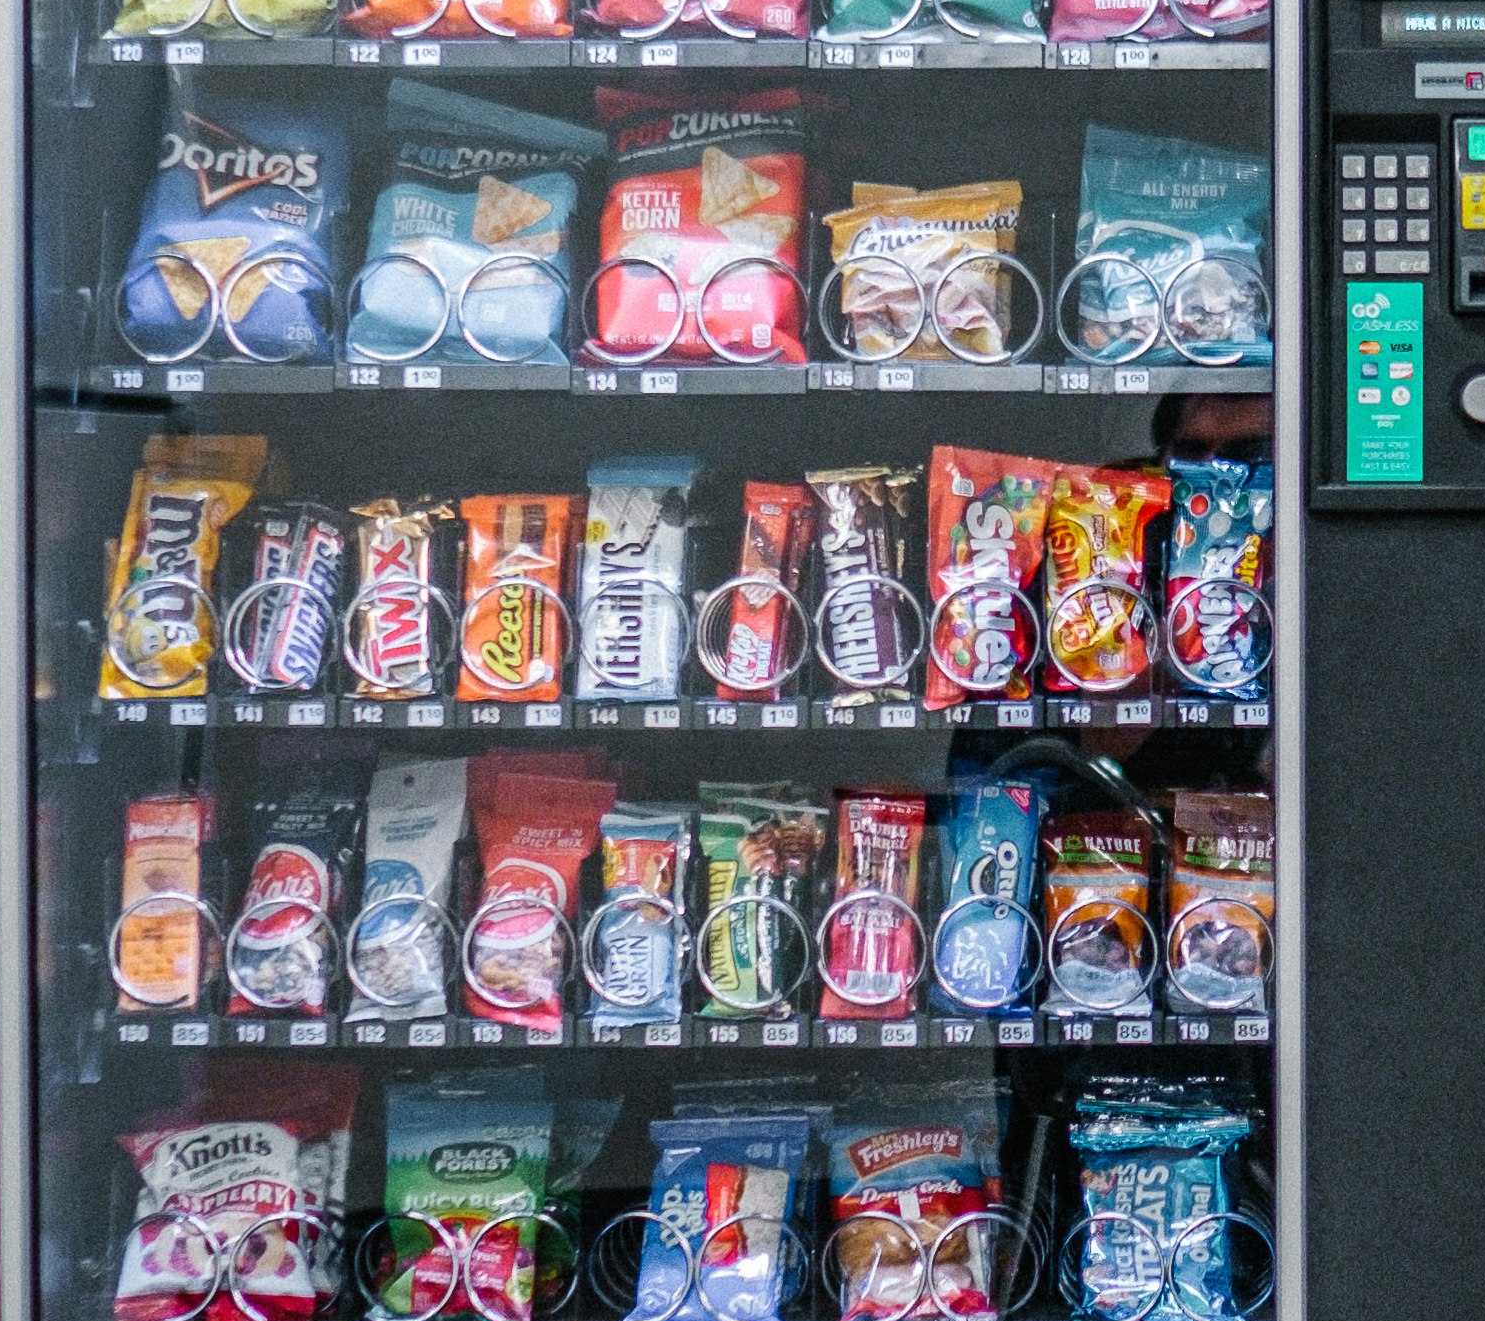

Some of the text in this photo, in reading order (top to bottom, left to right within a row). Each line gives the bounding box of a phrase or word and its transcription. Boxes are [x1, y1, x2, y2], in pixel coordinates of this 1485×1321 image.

[1405, 15, 1437, 31] HAVE
[1442, 15, 1451, 31] A
[587, 46, 618, 64] 124
[159, 133, 319, 188] Doritos
[1142, 181, 1228, 199] ALL ENERGY
[393, 196, 458, 224] WHITE
[620, 190, 682, 213] KETTLE
[1169, 196, 1199, 212] MIX
[620, 209, 682, 232] CORN
[1351, 302, 1381, 319] GO
[1389, 343, 1414, 353] VISA
[366, 537, 414, 685] TWIX
[169, 1132, 272, 1177] Knott's
[441, 1146, 507, 1160] BLACK
[858, 1130, 959, 1167] Freshley's
[434, 1158, 512, 1173] FOREST
